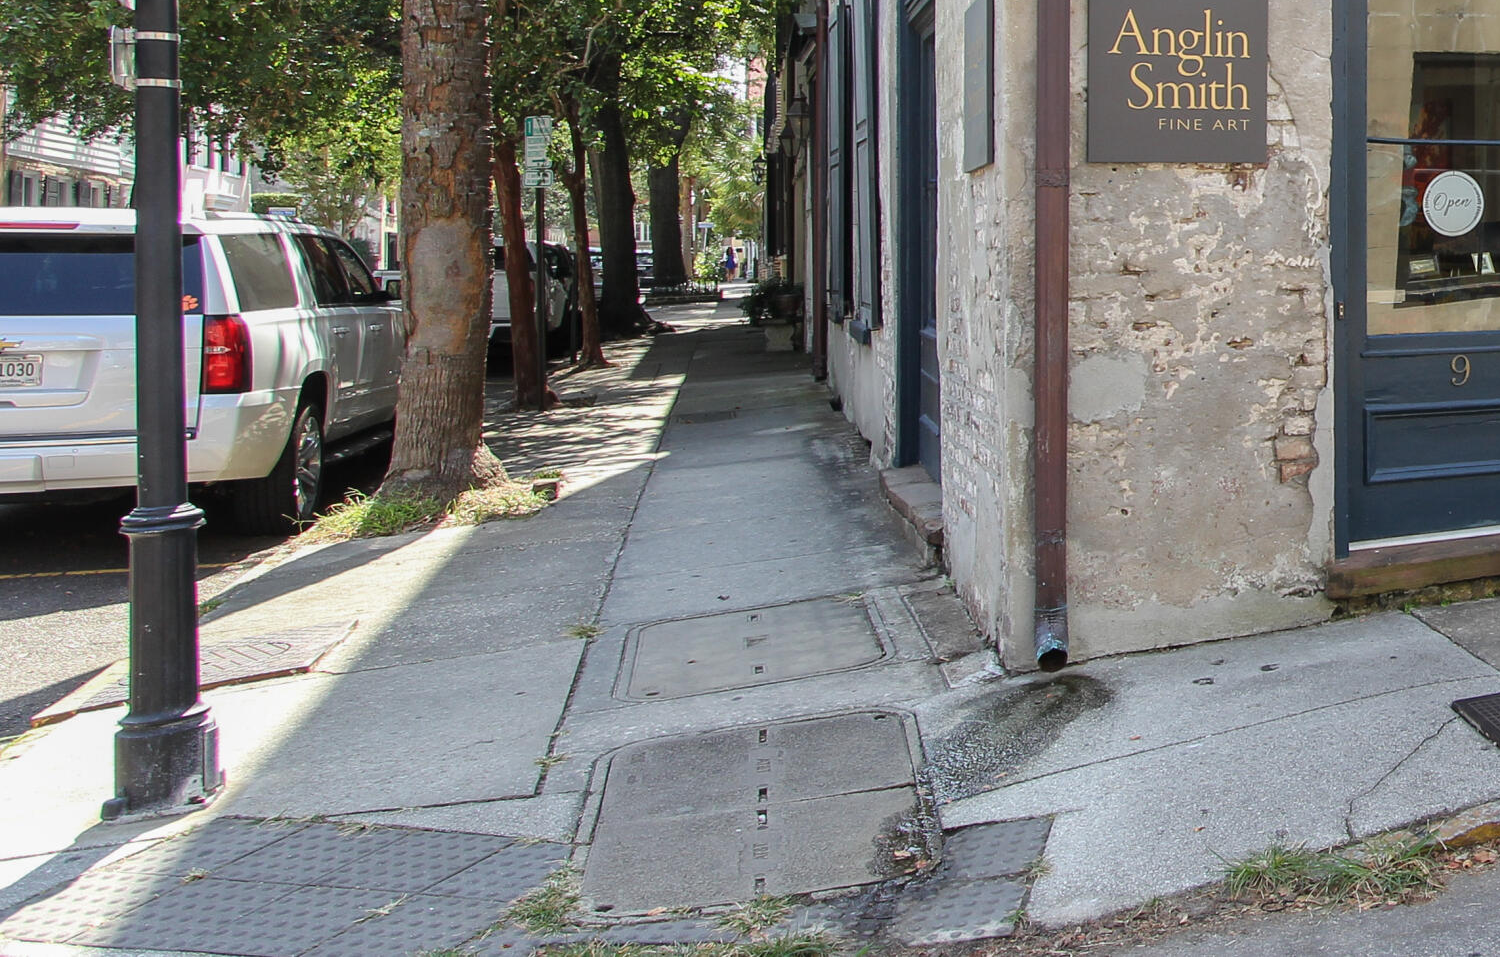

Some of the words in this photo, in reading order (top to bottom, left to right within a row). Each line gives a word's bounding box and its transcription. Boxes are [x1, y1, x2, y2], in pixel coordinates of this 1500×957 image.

[1107, 8, 1251, 77] Anglin
[1127, 62, 1251, 111] Smith
[1158, 118, 1203, 131] FINE
[1212, 119, 1251, 131] ART
[1432, 192, 1473, 217] Open
[1451, 354, 1470, 386] 9
